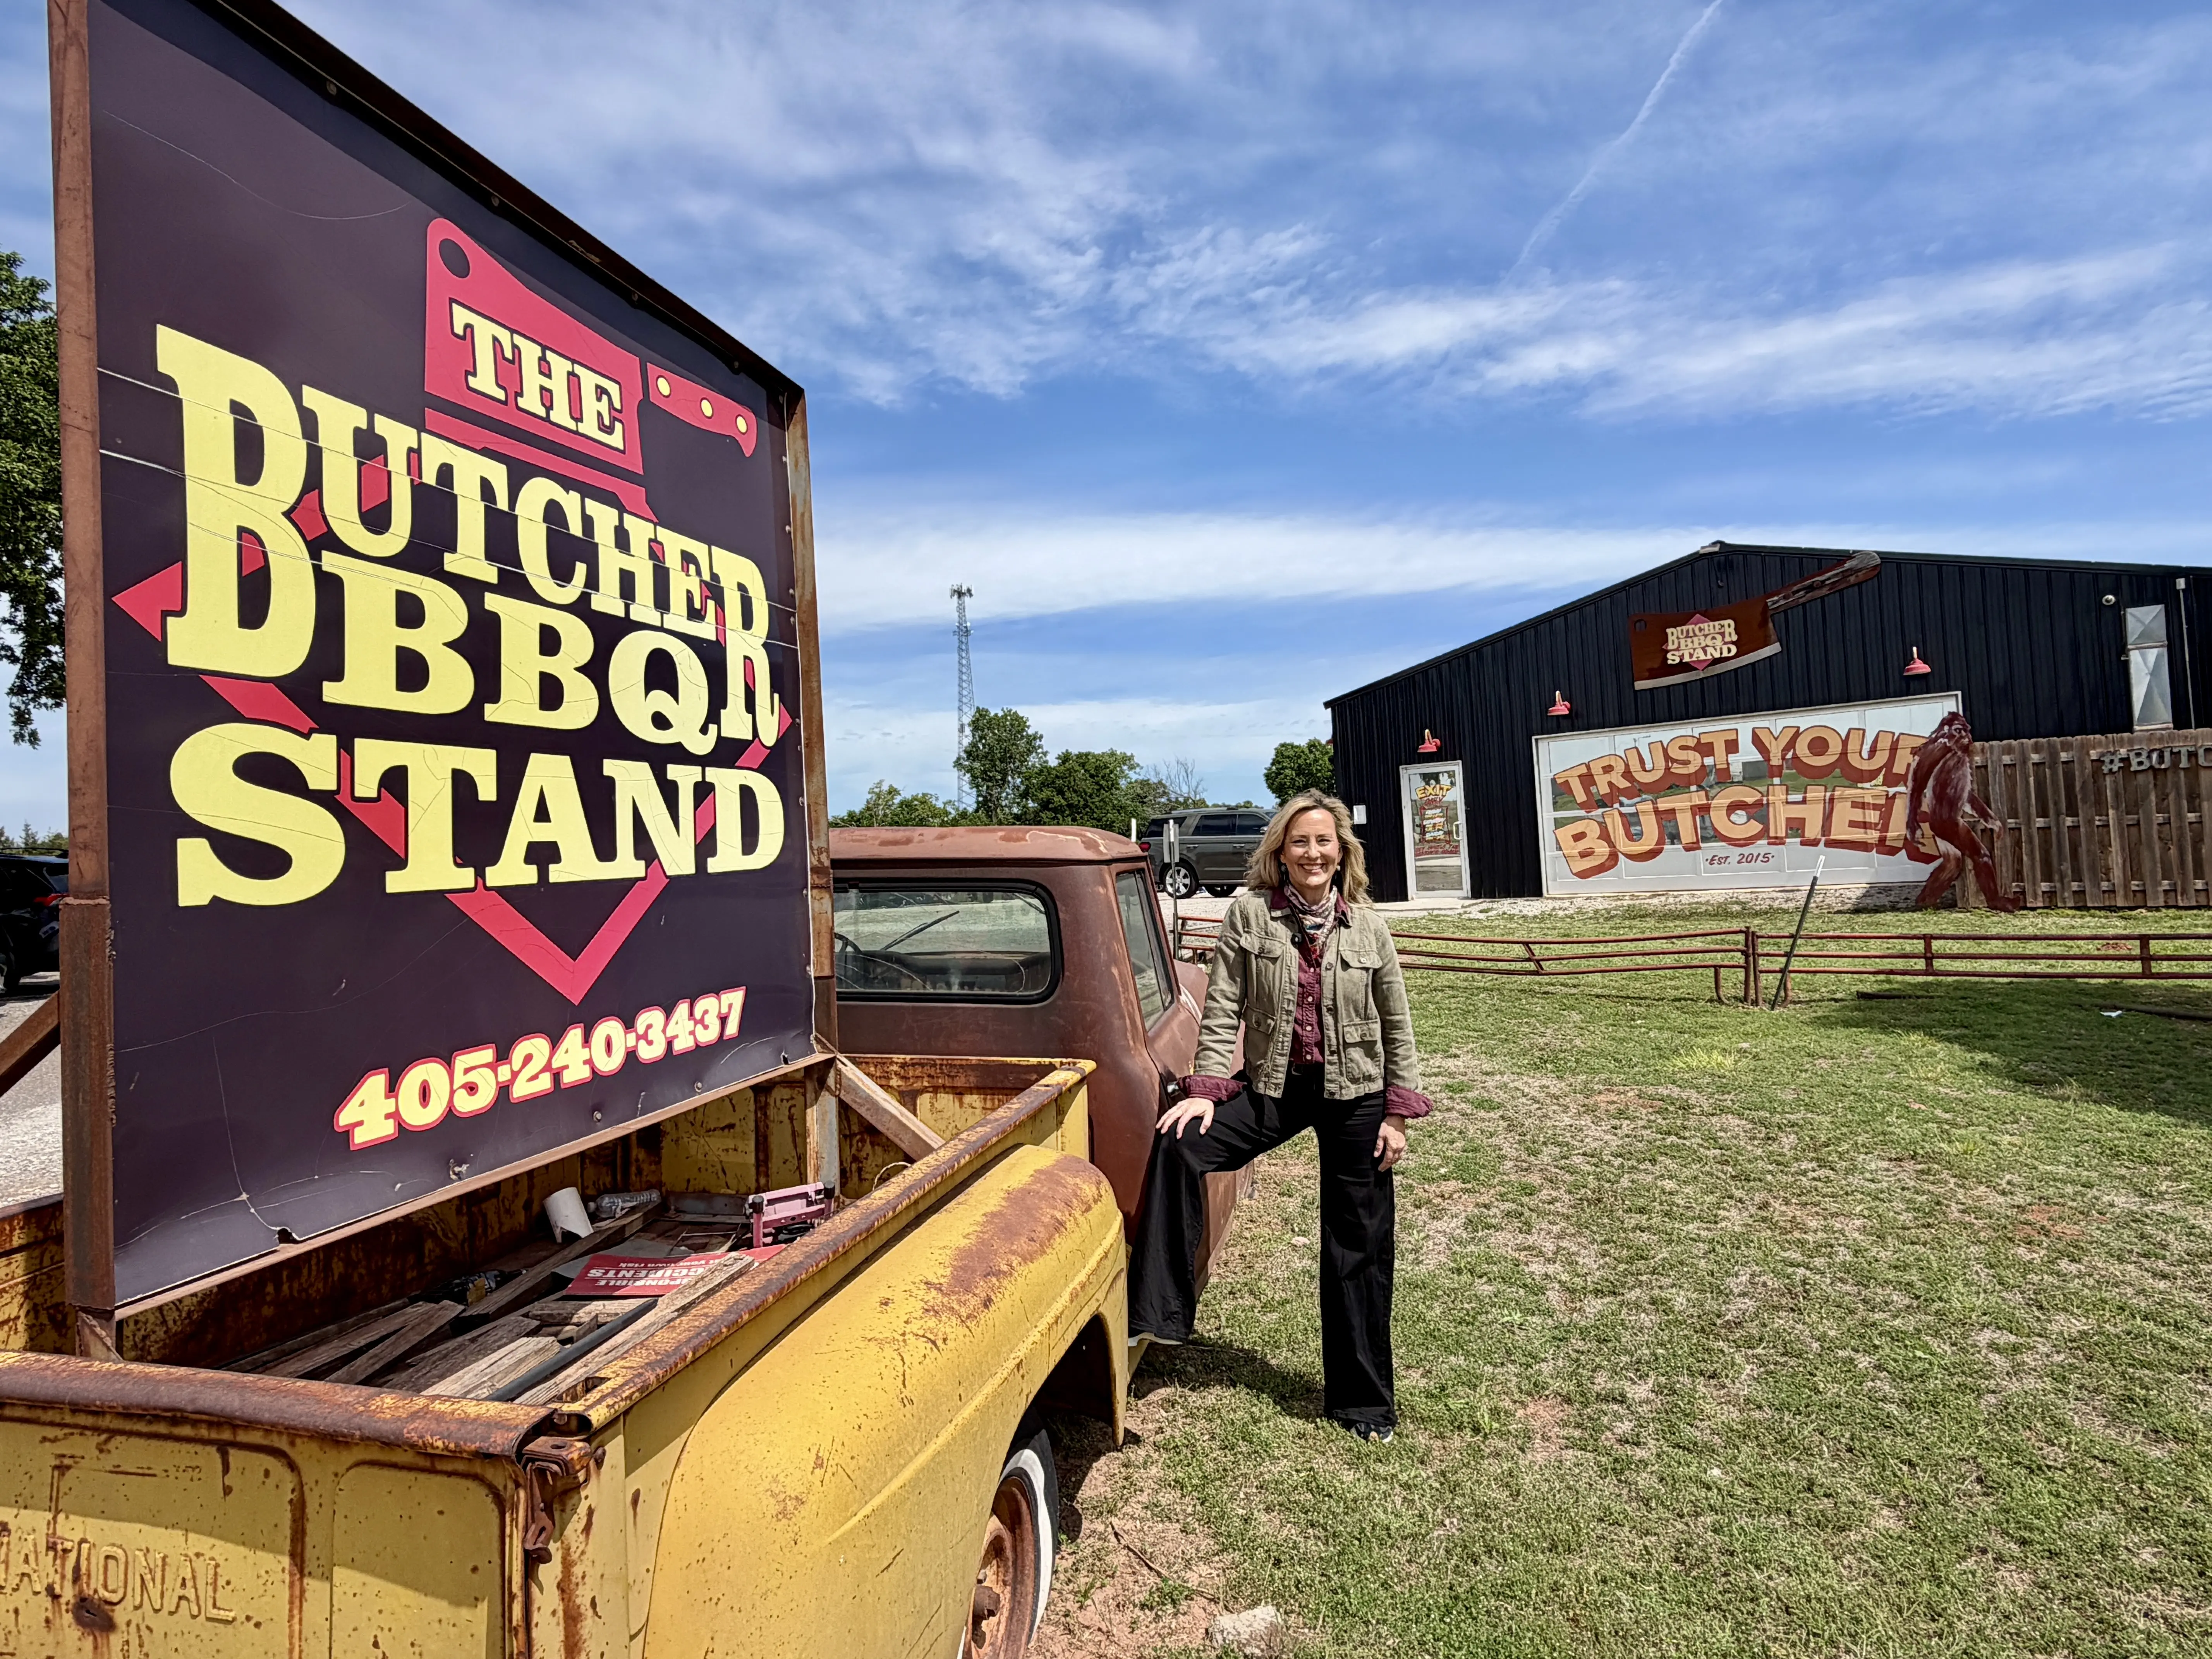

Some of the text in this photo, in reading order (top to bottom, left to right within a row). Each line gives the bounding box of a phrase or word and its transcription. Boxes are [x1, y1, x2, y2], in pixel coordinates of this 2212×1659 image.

[451, 303, 625, 451] THE
[156, 324, 780, 747] BUTCHER
[321, 551, 717, 755] BBQ
[1666, 620, 1738, 650] BUTCHER
[1667, 644, 1737, 664] STAND
[1678, 634, 1724, 650] BBQ
[1415, 784, 1452, 799] EXIT
[1554, 728, 1739, 813] TRUST
[170, 723, 785, 906] STAND
[1709, 855, 1731, 866] EST.
[334, 986, 747, 1151] 405-240-3437
[587, 1267, 708, 1277] CCIDENTS
